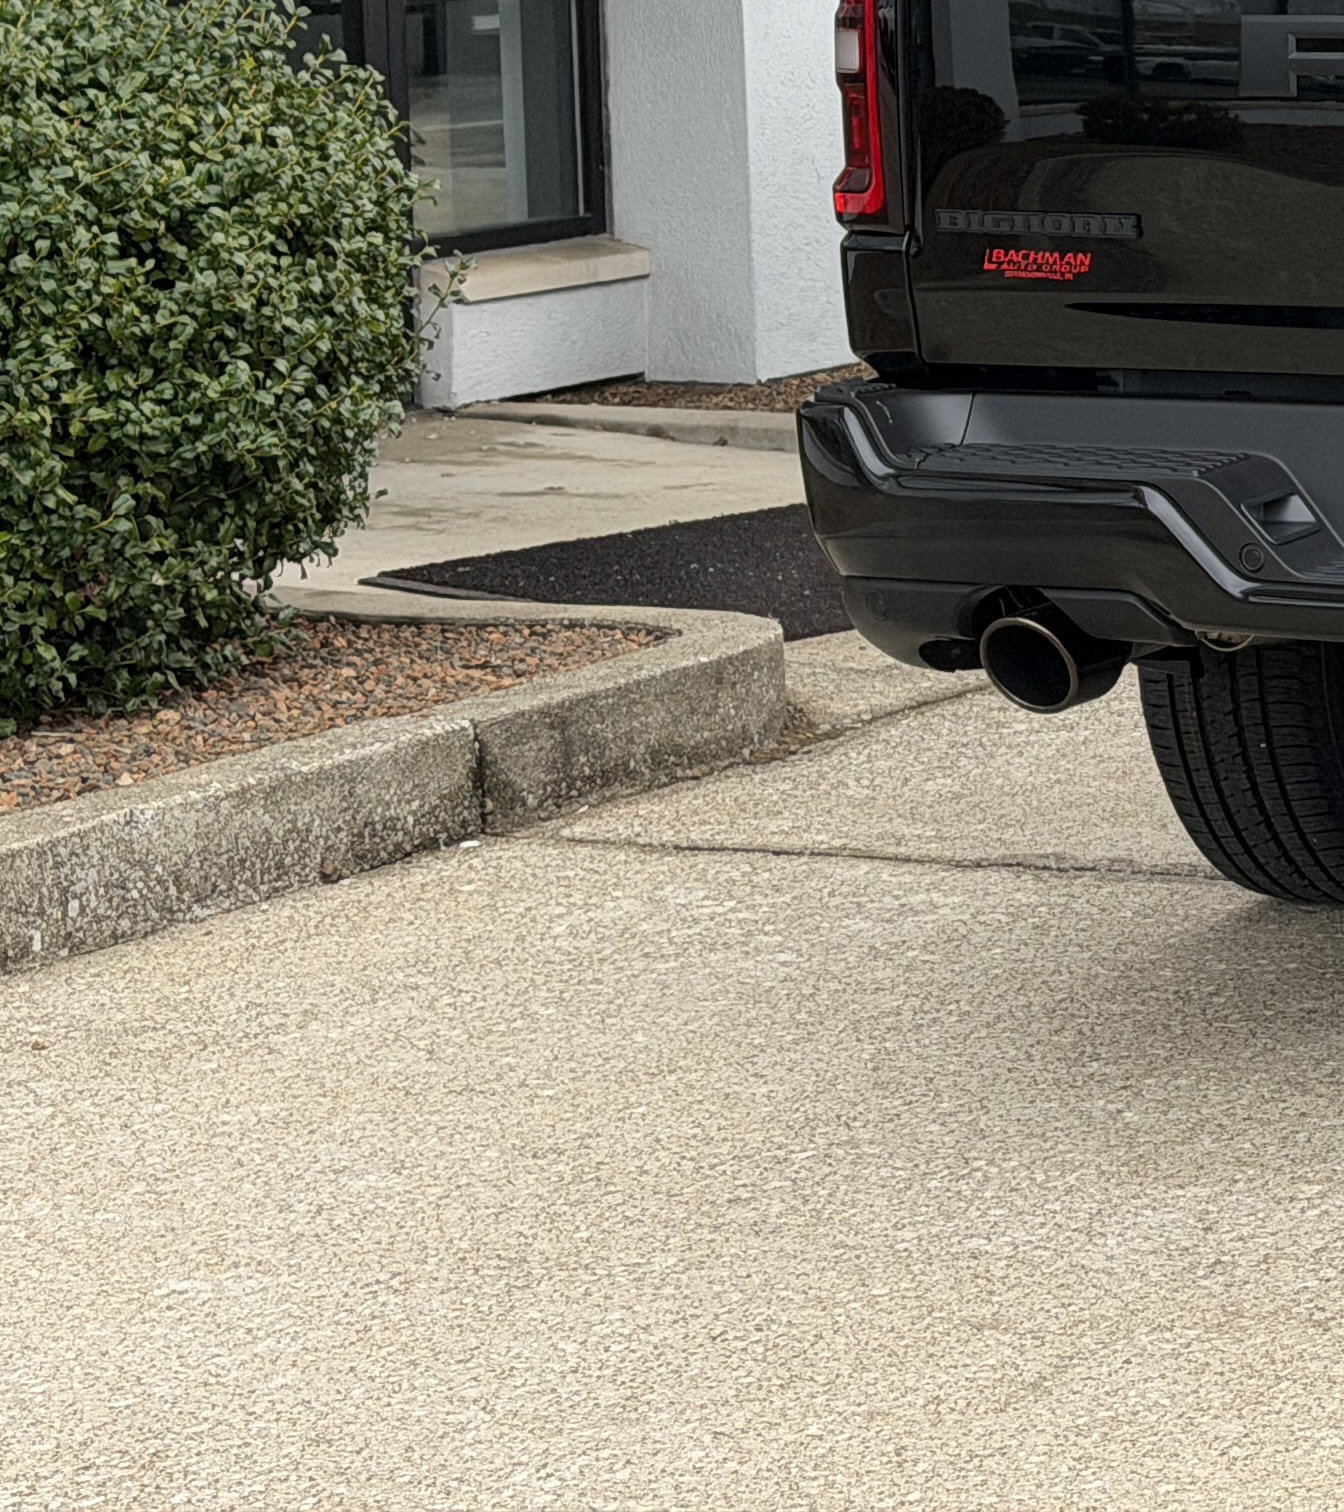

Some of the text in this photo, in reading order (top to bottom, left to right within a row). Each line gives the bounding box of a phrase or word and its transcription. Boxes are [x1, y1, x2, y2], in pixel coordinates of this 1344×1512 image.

[992, 248, 1092, 266] BACHMAN
[1000, 262, 1089, 273] AUTO GROUP
